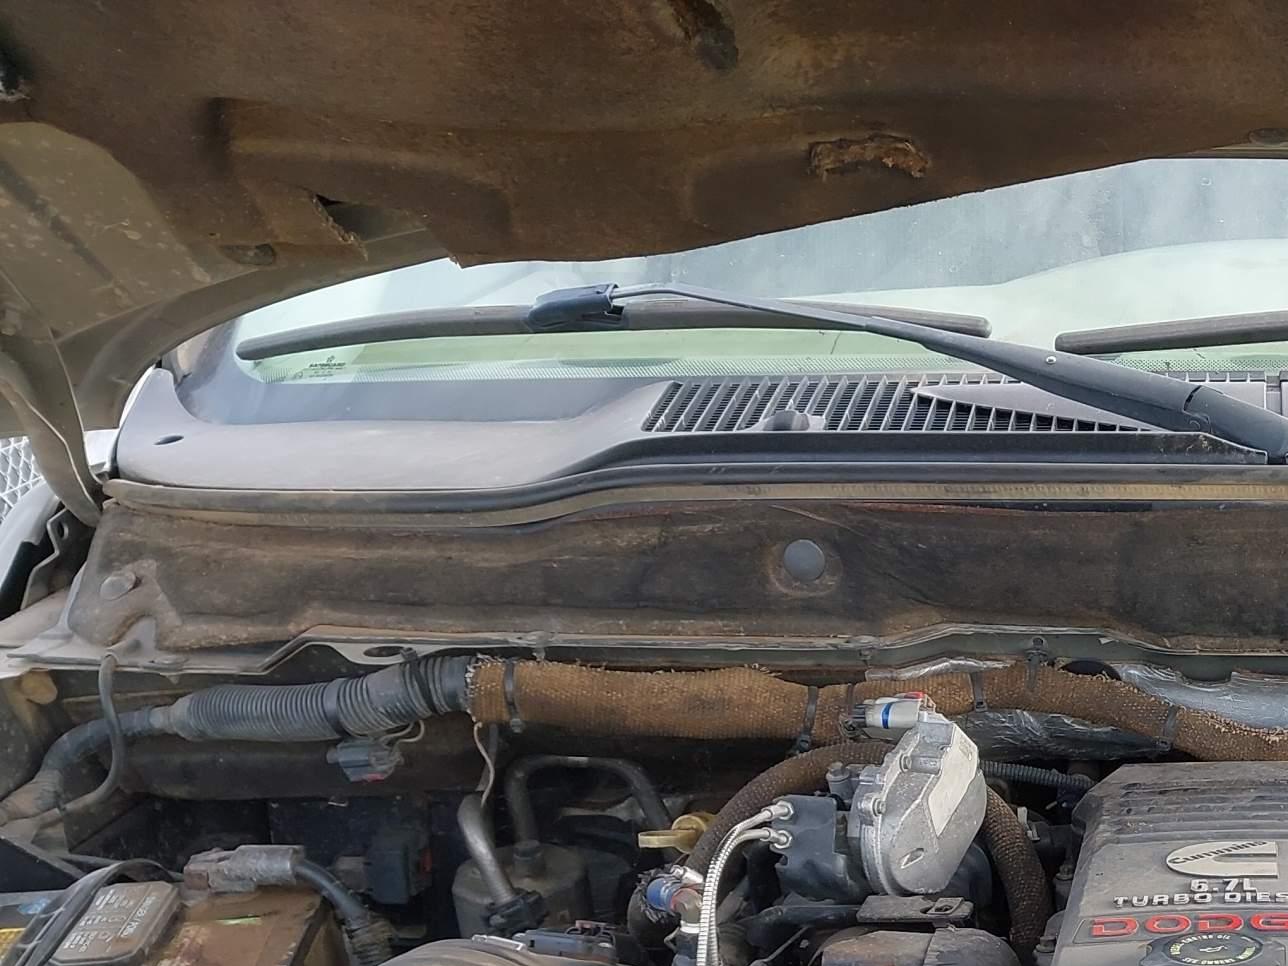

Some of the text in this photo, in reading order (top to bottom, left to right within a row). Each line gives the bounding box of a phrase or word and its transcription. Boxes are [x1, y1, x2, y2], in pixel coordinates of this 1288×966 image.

[1170, 840, 1268, 865] Cummins
[1190, 878, 1257, 892] 6.7L
[1113, 893, 1212, 908] TURBO
